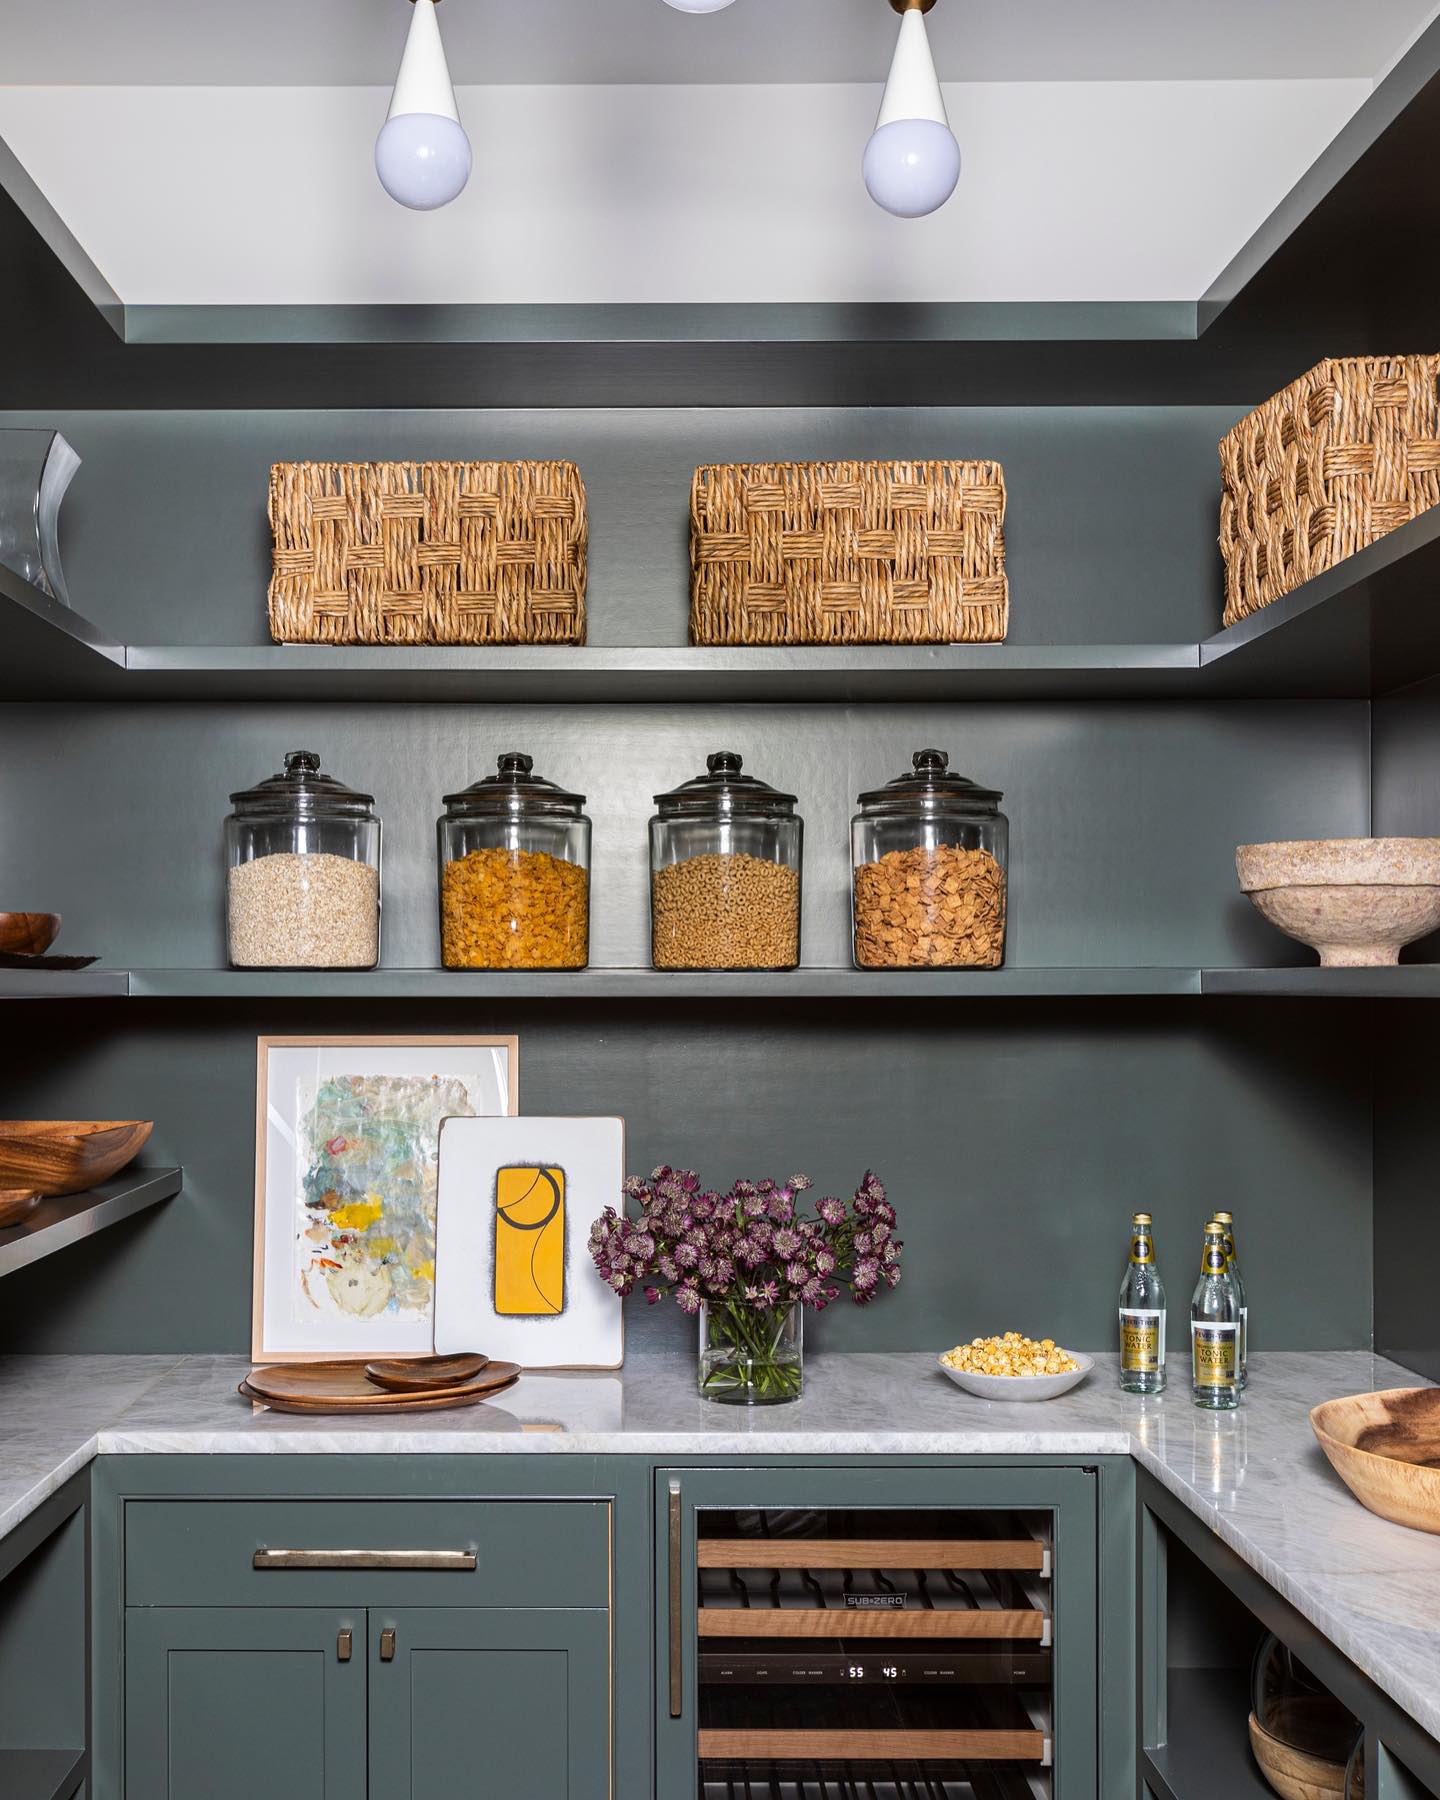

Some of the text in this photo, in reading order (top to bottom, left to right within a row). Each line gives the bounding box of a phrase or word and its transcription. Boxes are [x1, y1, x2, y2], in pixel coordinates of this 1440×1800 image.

[1125, 1335, 1152, 1343] TONIC
[1125, 1342, 1152, 1350] WATER
[1201, 1349, 1229, 1357] TONIC
[1199, 1356, 1229, 1364] WATER
[848, 1666, 865, 1679] 55
[882, 1666, 898, 1679] 45
